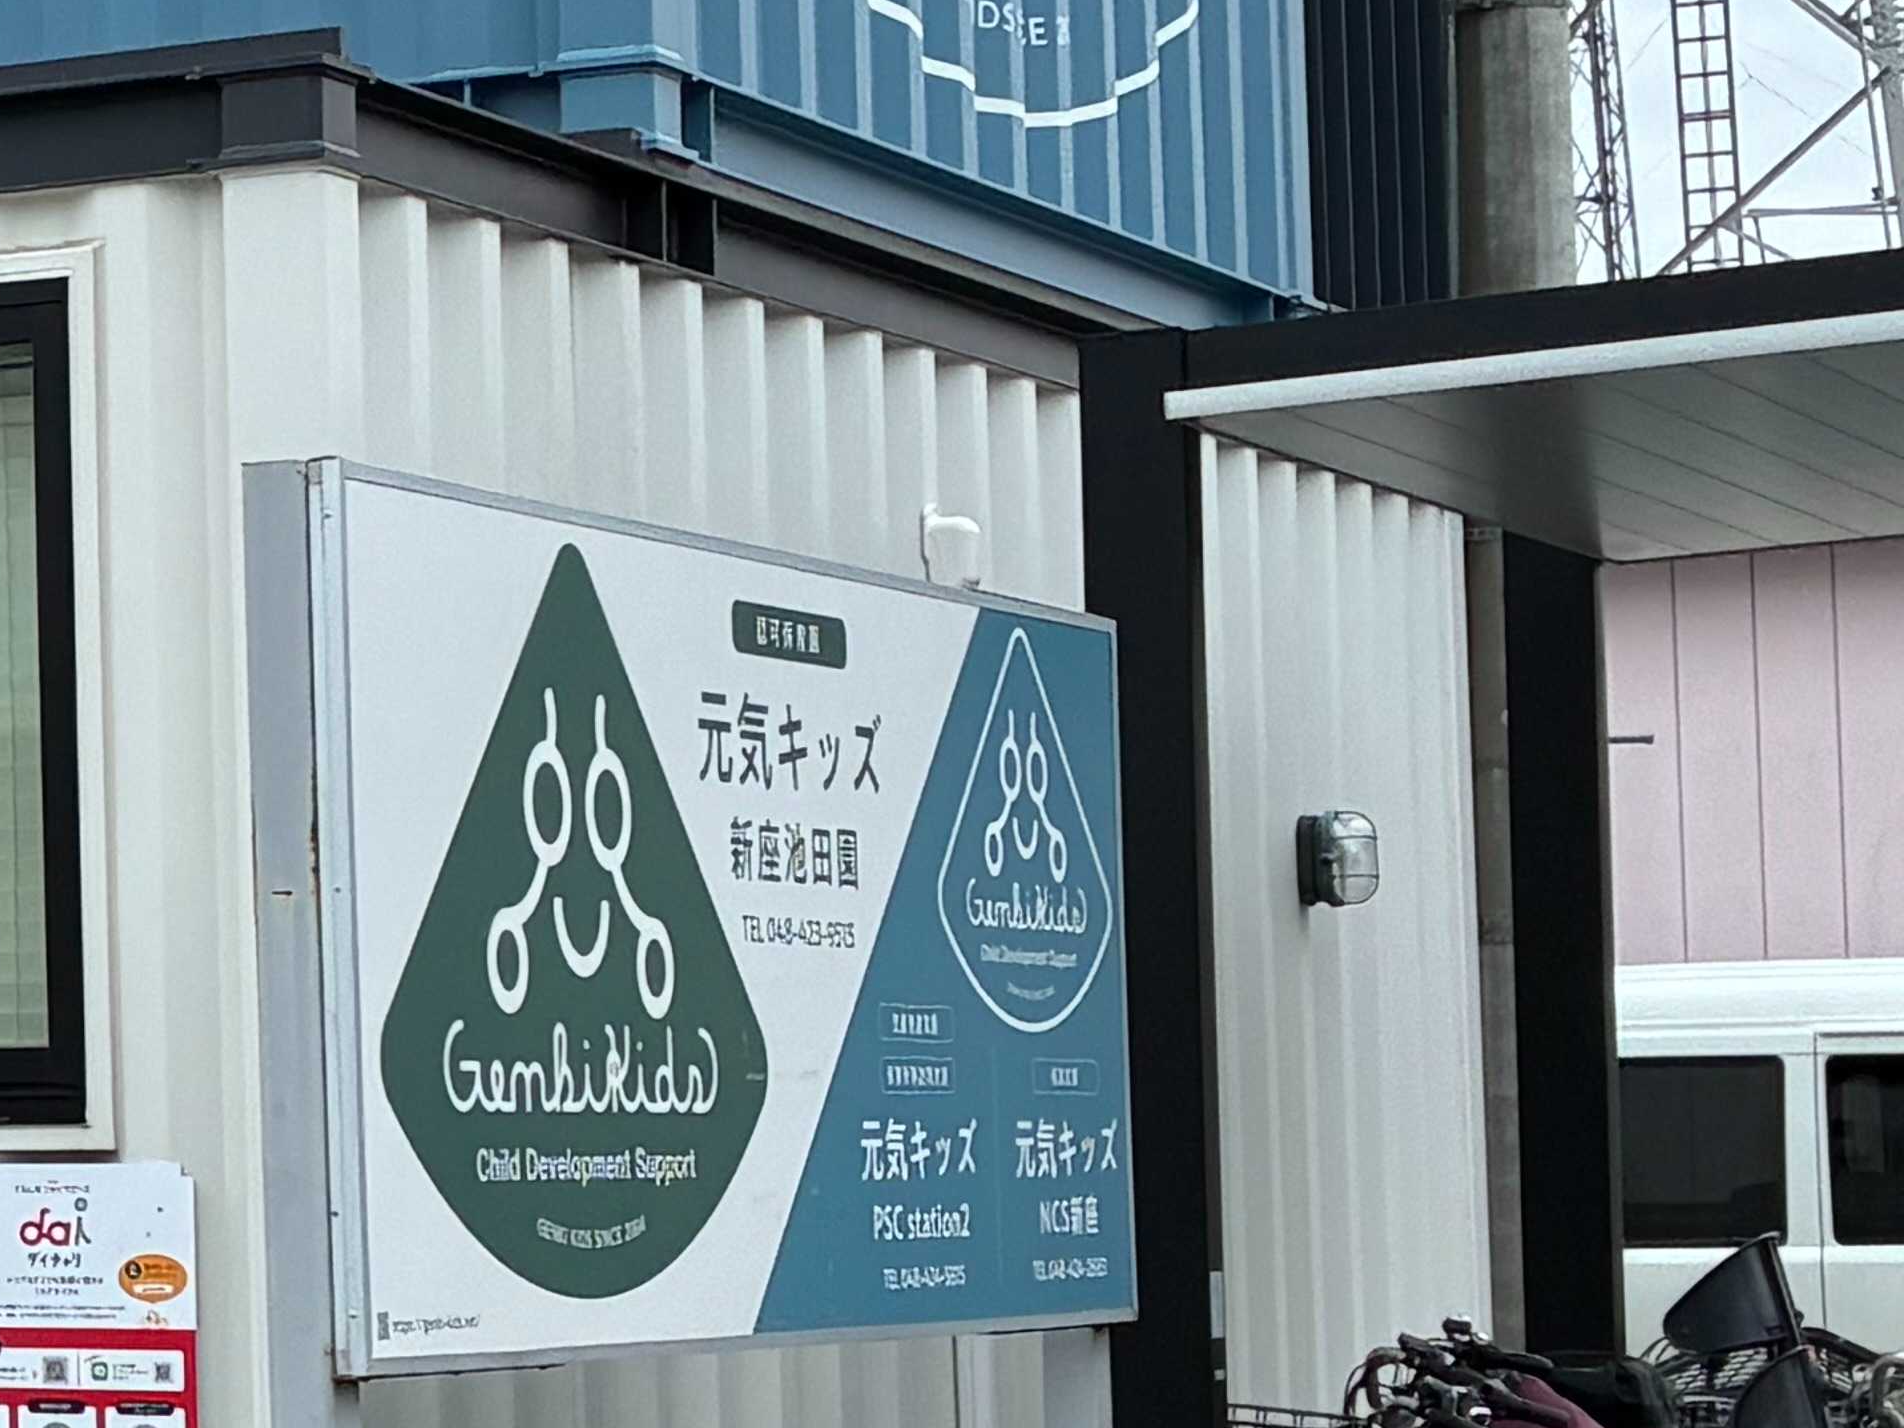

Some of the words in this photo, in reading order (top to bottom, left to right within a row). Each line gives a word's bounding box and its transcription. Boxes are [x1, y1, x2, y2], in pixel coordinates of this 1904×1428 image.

[698, 691, 882, 793] 元気キッズ
[730, 815, 859, 890] 新座池田園
[742, 914, 764, 944] TEL
[476, 1148, 521, 1182] Child
[525, 1148, 632, 1187] Development
[635, 1146, 696, 1186] Support
[861, 1118, 977, 1181] 元気キッズ
[1016, 1118, 1118, 1178] 元気キッズ
[19, 1197, 92, 1246] dai
[873, 1204, 903, 1241] PSC
[907, 1202, 970, 1240] station2
[27, 1252, 81, 1268] ダイチャリ
